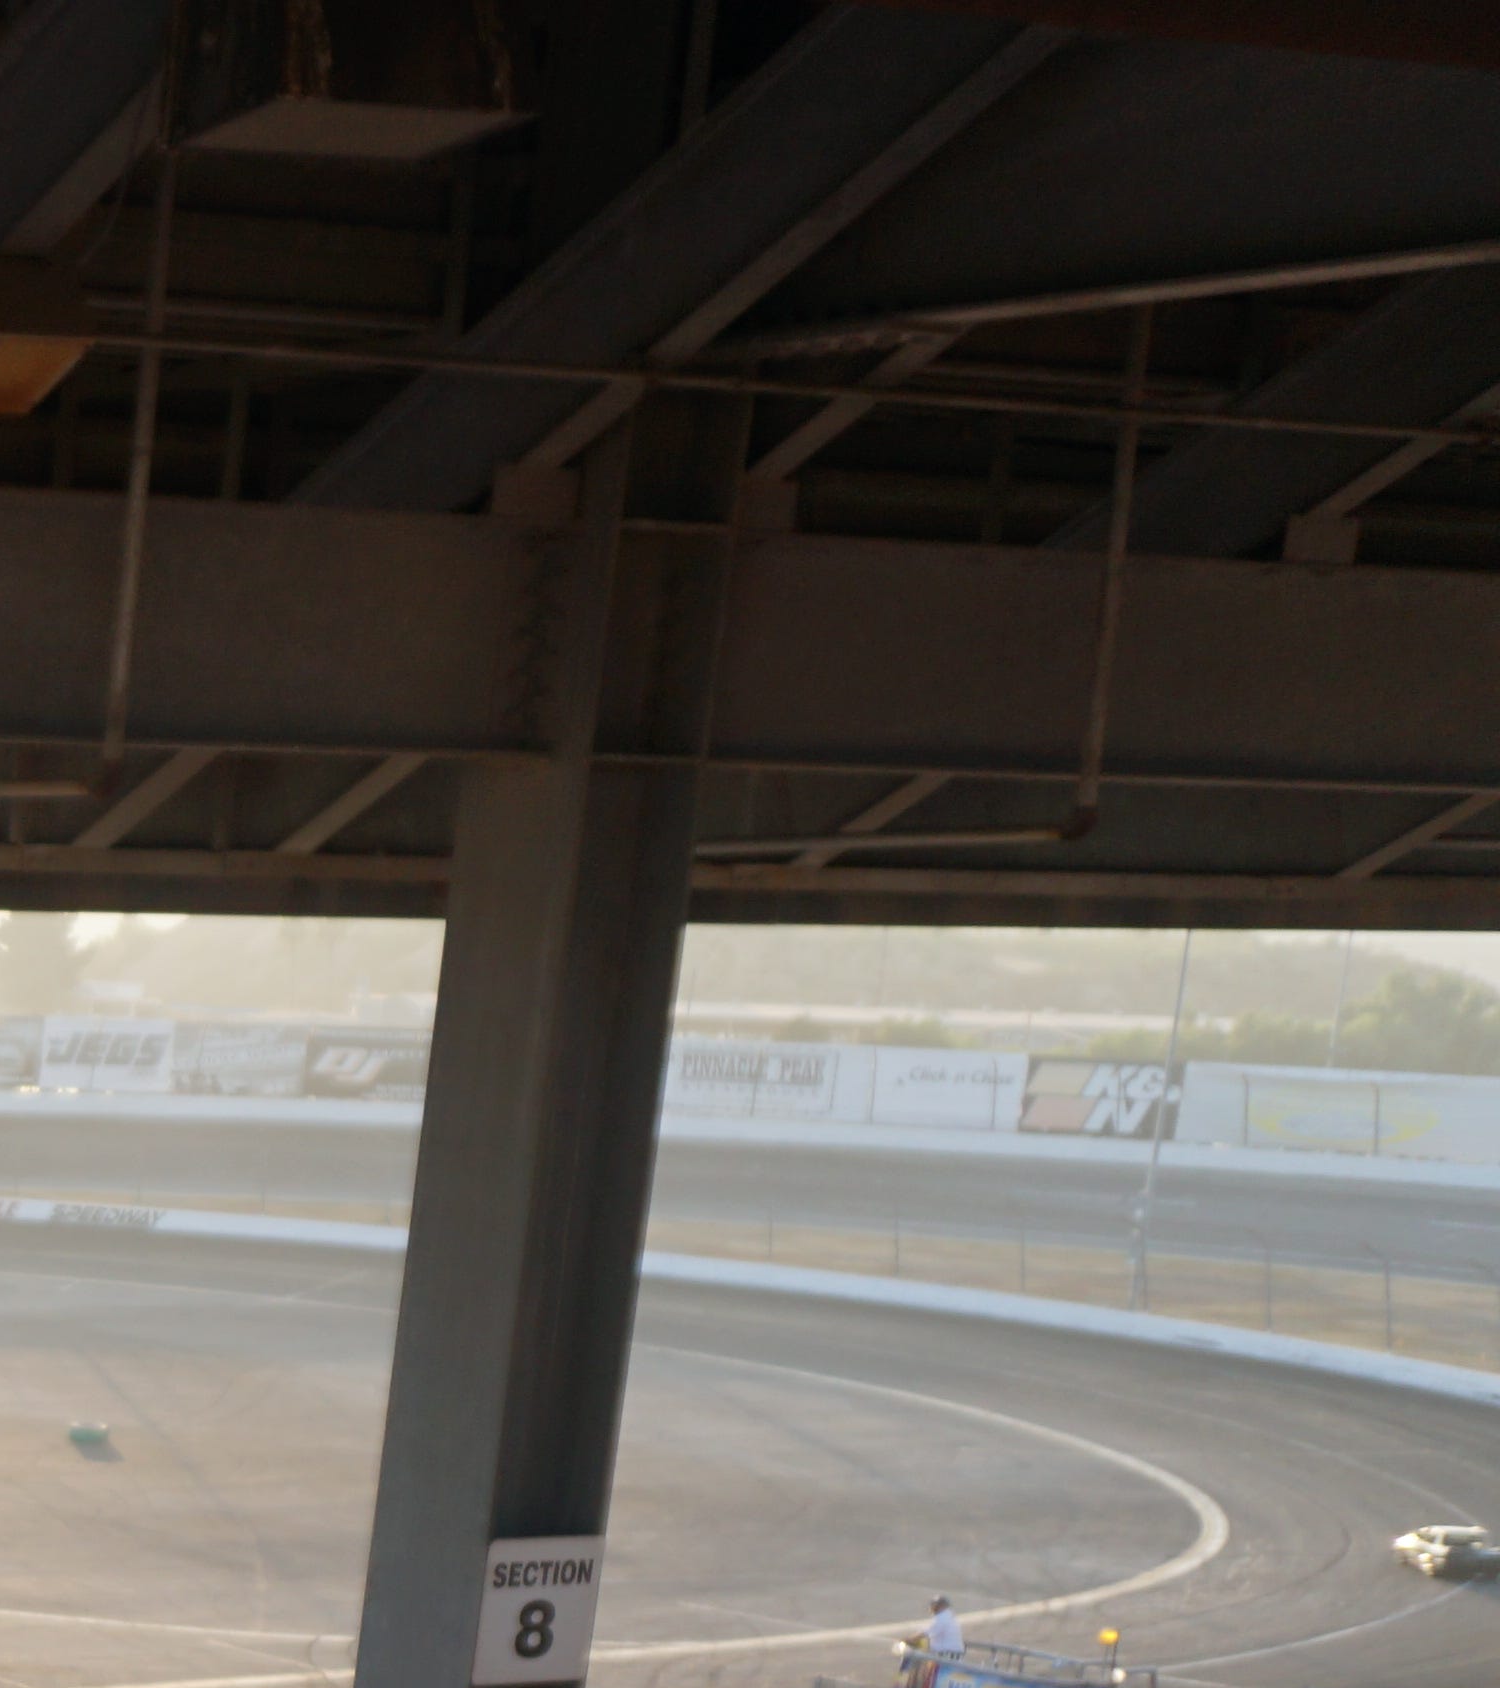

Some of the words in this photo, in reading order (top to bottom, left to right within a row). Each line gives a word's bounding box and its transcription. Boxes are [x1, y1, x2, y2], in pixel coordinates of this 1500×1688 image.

[46, 1031, 172, 1065] JEGS
[492, 1558, 595, 1589] SECTION
[513, 1598, 556, 1659] 8
